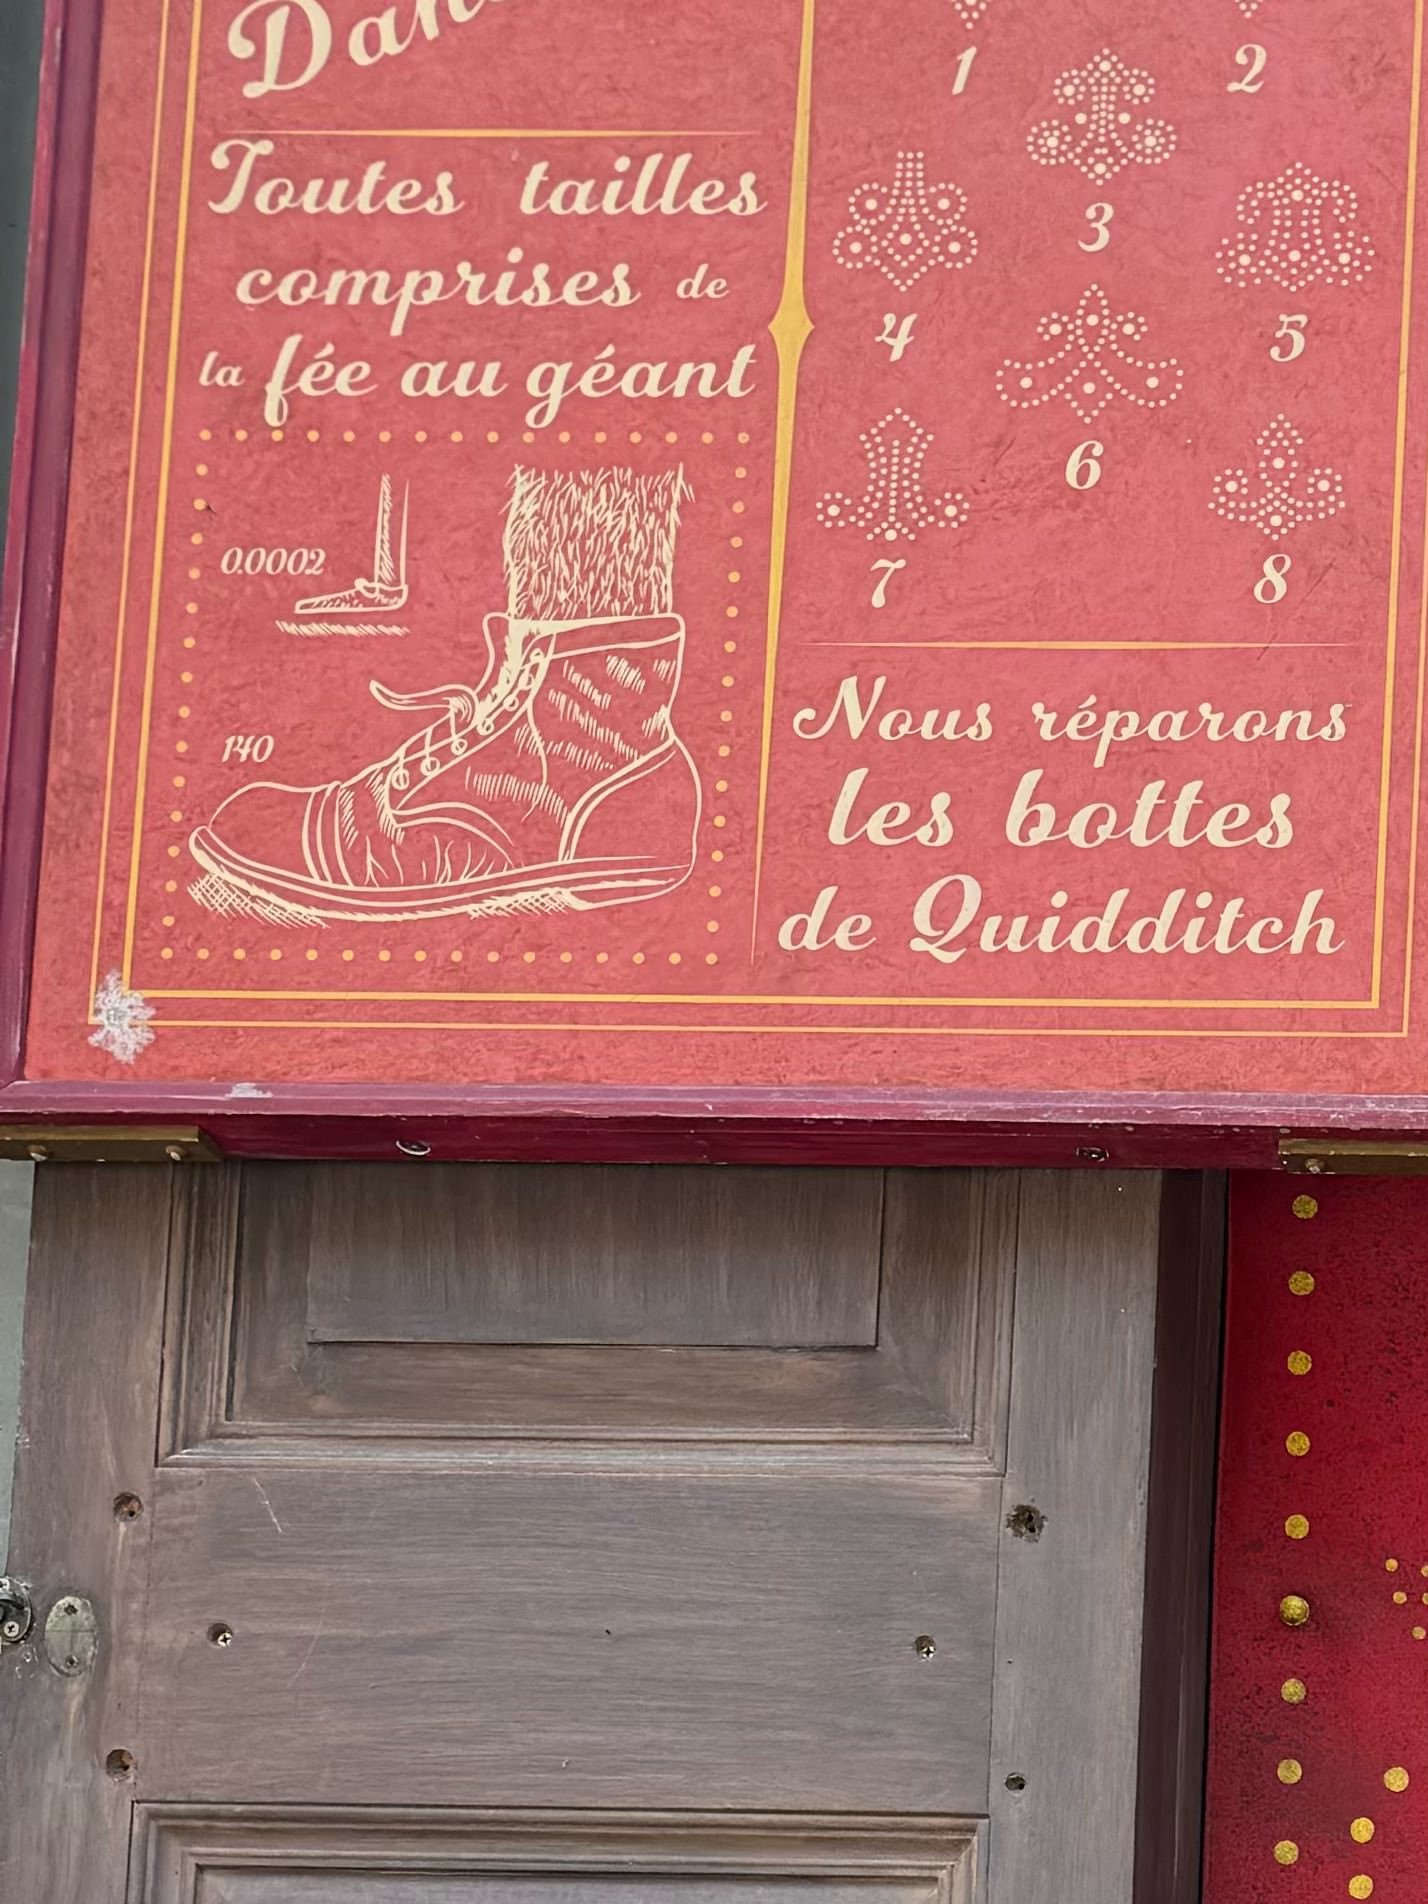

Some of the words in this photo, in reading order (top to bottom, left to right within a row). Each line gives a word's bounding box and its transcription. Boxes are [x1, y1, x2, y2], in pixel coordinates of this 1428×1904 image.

[952, 46, 977, 95] 1
[1226, 44, 1267, 94] 2
[208, 139, 464, 215] Toutes
[519, 153, 767, 216] tailles
[1078, 202, 1114, 252] 3
[236, 247, 641, 337] comprises
[676, 263, 727, 299] de
[875, 313, 917, 362] 4
[1269, 314, 1308, 362] 5
[199, 351, 241, 387] la
[264, 334, 377, 427] fée
[400, 366, 508, 397] au
[525, 343, 756, 429] géant
[1065, 440, 1104, 490] 6
[220, 547, 326, 575] 0.0002
[870, 558, 906, 609] 7
[1253, 553, 1292, 604] 8
[792, 675, 993, 741] Nous
[1029, 694, 1346, 768] réparons
[222, 735, 274, 763] 140
[828, 767, 954, 847] les
[1005, 768, 1294, 849] bottes
[778, 885, 877, 951] de
[909, 874, 1346, 964] Quidditch
